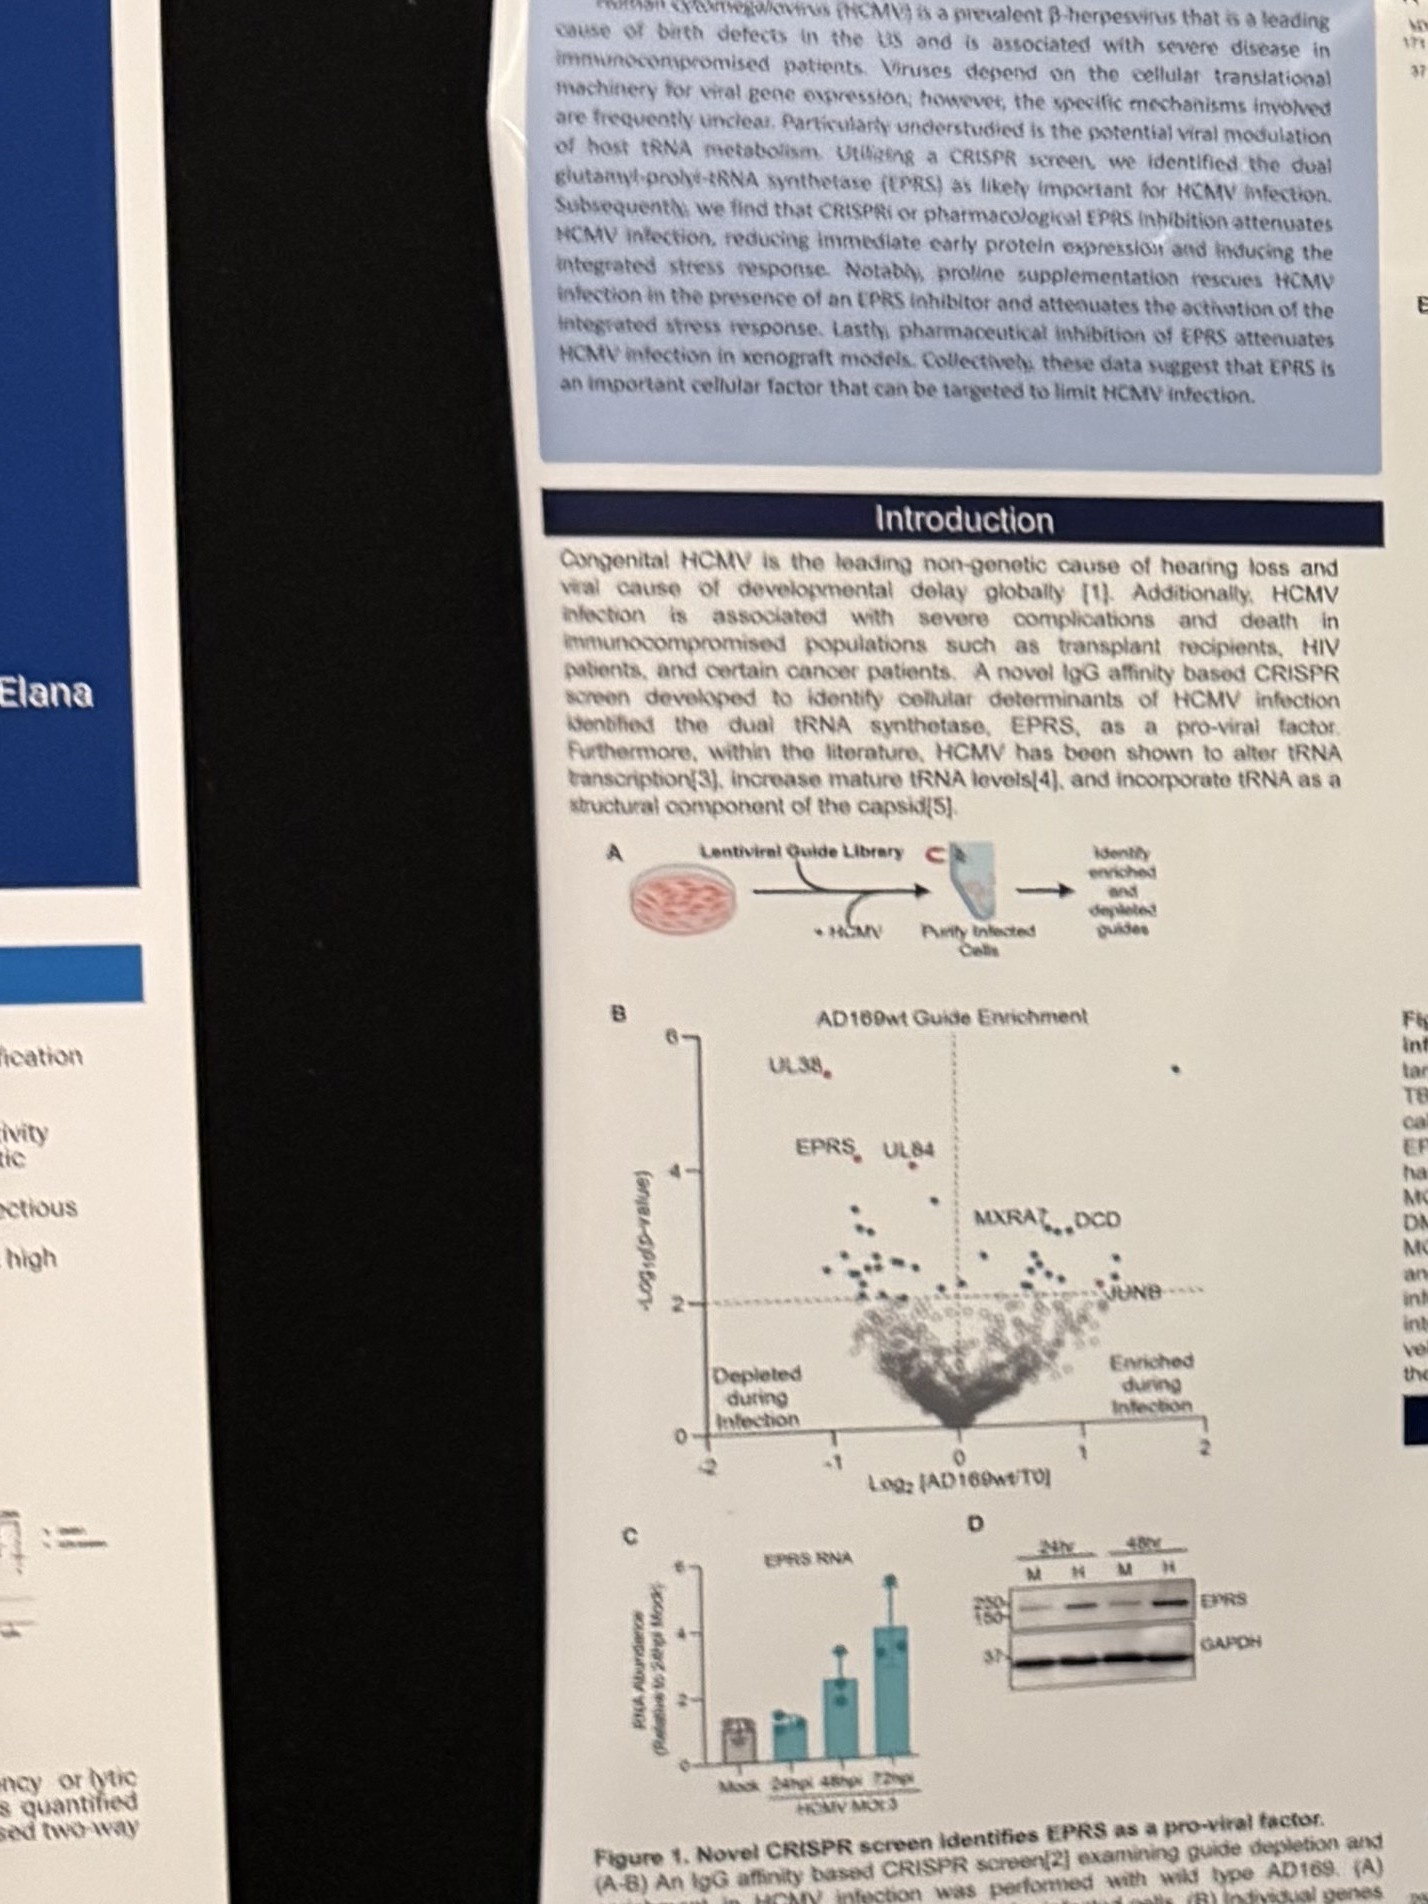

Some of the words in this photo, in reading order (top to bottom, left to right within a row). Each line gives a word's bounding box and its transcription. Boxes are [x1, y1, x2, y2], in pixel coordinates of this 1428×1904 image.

[559, 377, 583, 392] an
[587, 376, 685, 395] important
[690, 375, 761, 395] cellular
[767, 377, 823, 396] factor
[829, 378, 869, 397] that
[873, 382, 908, 398] can
[912, 379, 937, 398] be
[942, 382, 1024, 403] targeted
[1028, 383, 1050, 400] to
[1054, 382, 1097, 401] limit
[1102, 384, 1163, 402] HCMV
[1167, 385, 1255, 404] infection.
[876, 505, 1054, 534] Introduction
[559, 548, 669, 574] Congenital
[680, 550, 752, 571] HCMV
[761, 552, 780, 570] is
[790, 552, 825, 572] the
[835, 552, 913, 577] leading
[923, 556, 1047, 577] non-genetic
[1056, 559, 1120, 575] cause
[1129, 556, 1152, 575] of
[1160, 556, 1238, 580] hearing
[1248, 558, 1290, 577] loss
[1300, 558, 1338, 577] and
[0, 672, 95, 708] Elana
[817, 1009, 909, 1027] AD169wt
[912, 1009, 972, 1027] Guide
[977, 1008, 1089, 1026] Enrichment
[796, 1136, 857, 1156] EPRS
[7, 1246, 58, 1273] high
[594, 1848, 665, 1871] Figure
[671, 1847, 689, 1864] 1.
[695, 1843, 760, 1863] Novel
[765, 1838, 853, 1860] CRISPR
[859, 1837, 933, 1855] screen
[939, 1828, 1039, 1850] identifies
[1046, 1821, 1108, 1843] EPRS
[1114, 1824, 1139, 1839] as
[1145, 1823, 1158, 1837] a
[1163, 1814, 1254, 1839] pro-viral
[1258, 1812, 1325, 1830] factor.
